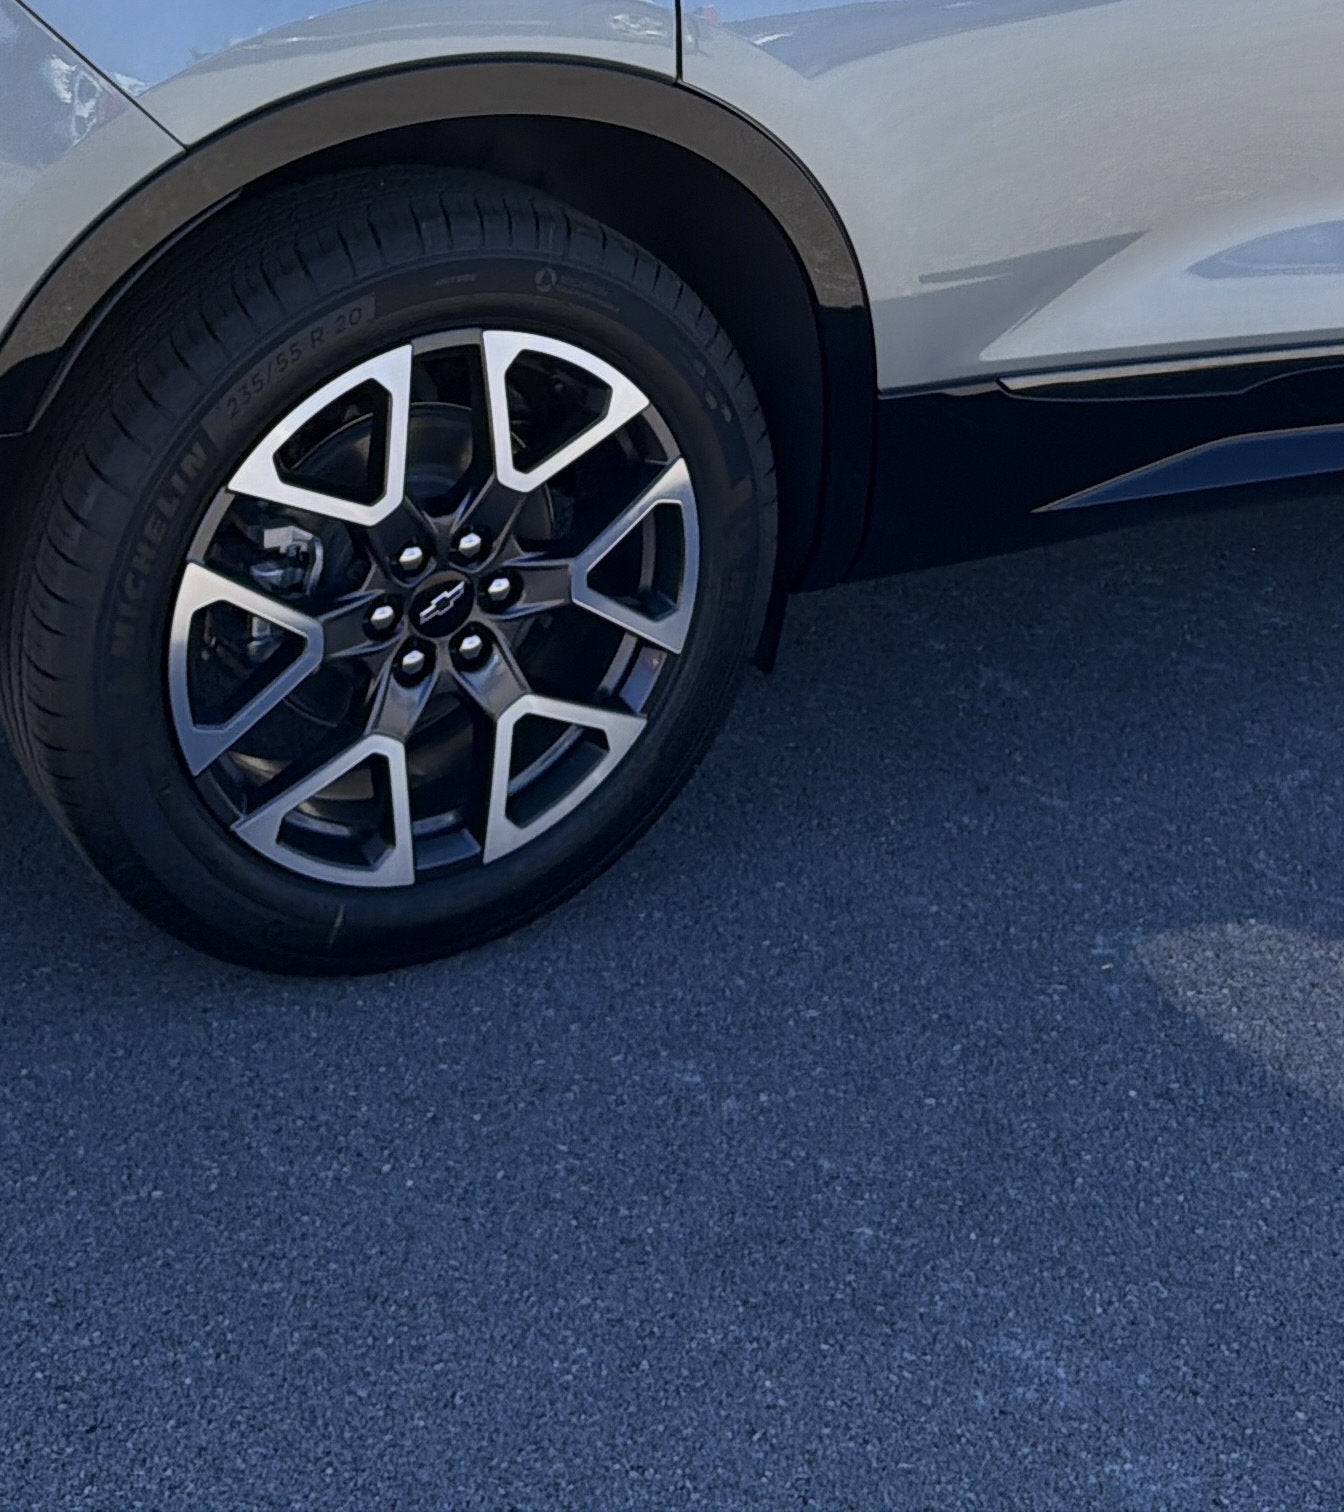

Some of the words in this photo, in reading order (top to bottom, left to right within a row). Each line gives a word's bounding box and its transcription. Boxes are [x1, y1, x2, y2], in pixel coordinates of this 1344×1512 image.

[225, 341, 303, 420] 235/55
[335, 306, 363, 334] 20
[111, 439, 209, 659] MICHELIN
